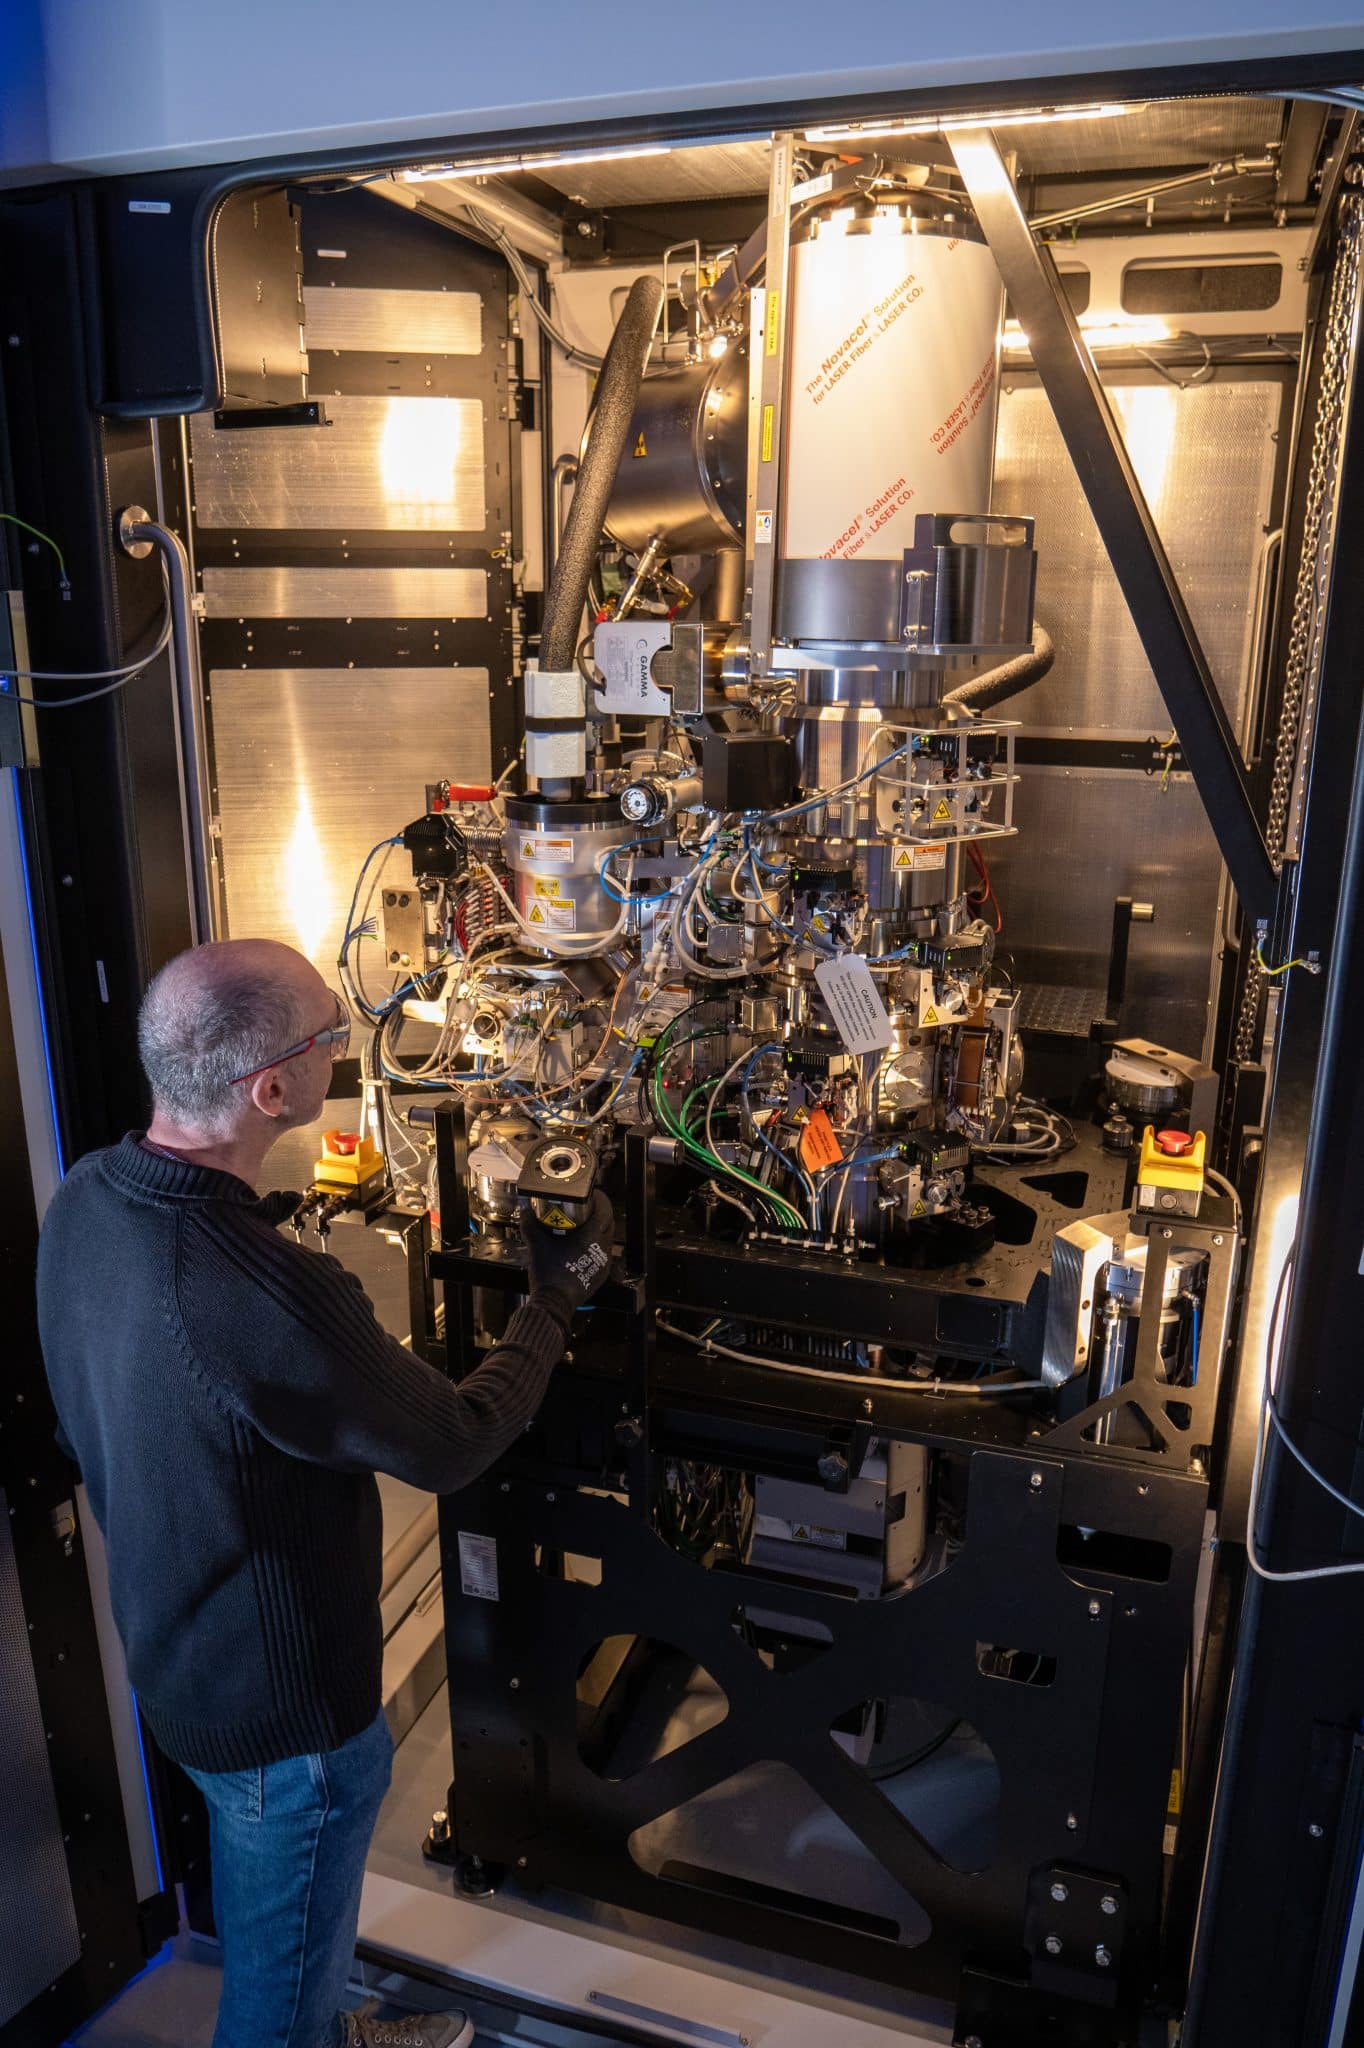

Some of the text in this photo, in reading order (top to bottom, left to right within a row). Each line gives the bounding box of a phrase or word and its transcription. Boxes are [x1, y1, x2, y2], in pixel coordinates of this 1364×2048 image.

[805, 374, 823, 394] The
[874, 274, 916, 316] Solution
[812, 390, 825, 404] for
[824, 360, 852, 391] LASER
[850, 336, 872, 362] Fiber
[878, 301, 908, 332] LASER
[937, 417, 968, 454] Solution
[944, 401, 966, 430] LASER
[866, 478, 906, 518] Solution
[842, 538, 865, 560] Fiber
[870, 504, 899, 533] LASER
[640, 656, 648, 698] GAMMA
[860, 988, 878, 1019] CAUTION
